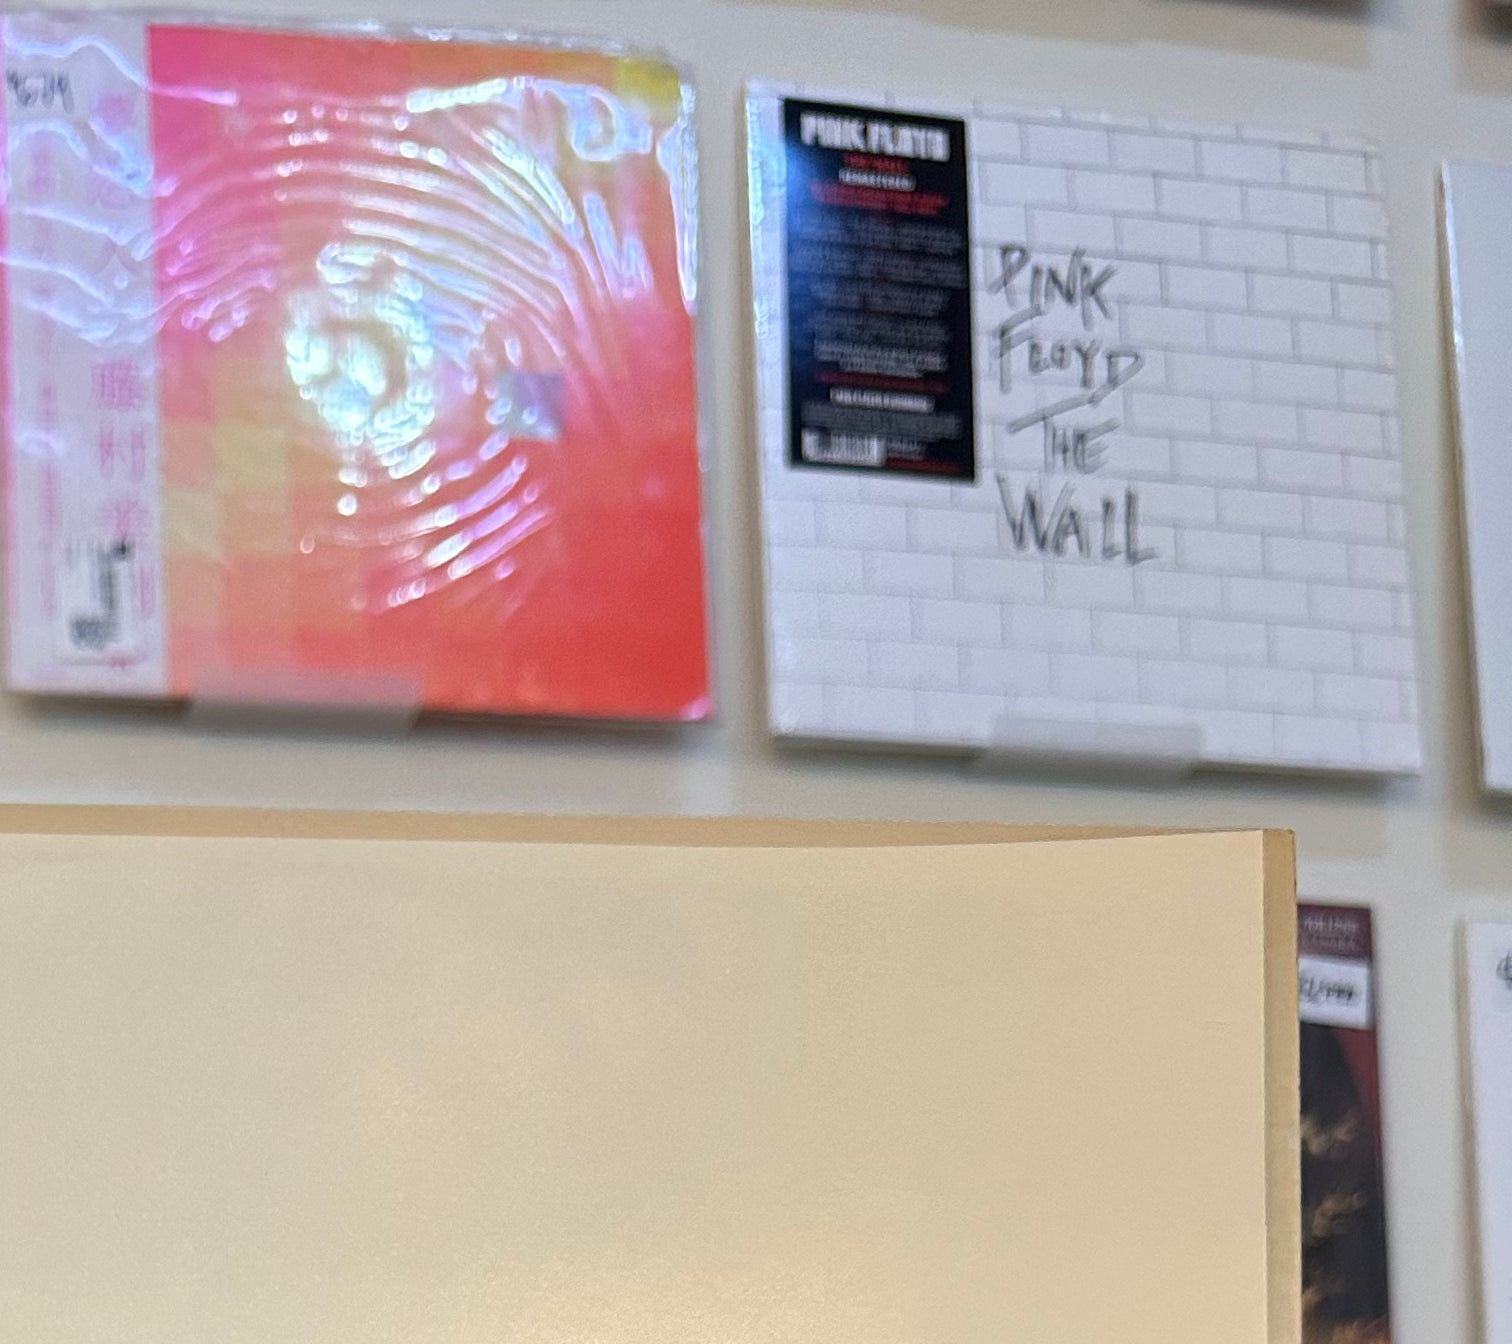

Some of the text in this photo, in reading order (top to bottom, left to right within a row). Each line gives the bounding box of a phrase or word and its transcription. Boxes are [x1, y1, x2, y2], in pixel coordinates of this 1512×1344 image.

[988, 246, 1117, 331] PINK
[1043, 417, 1120, 474] THE
[996, 474, 1159, 564] WALL
